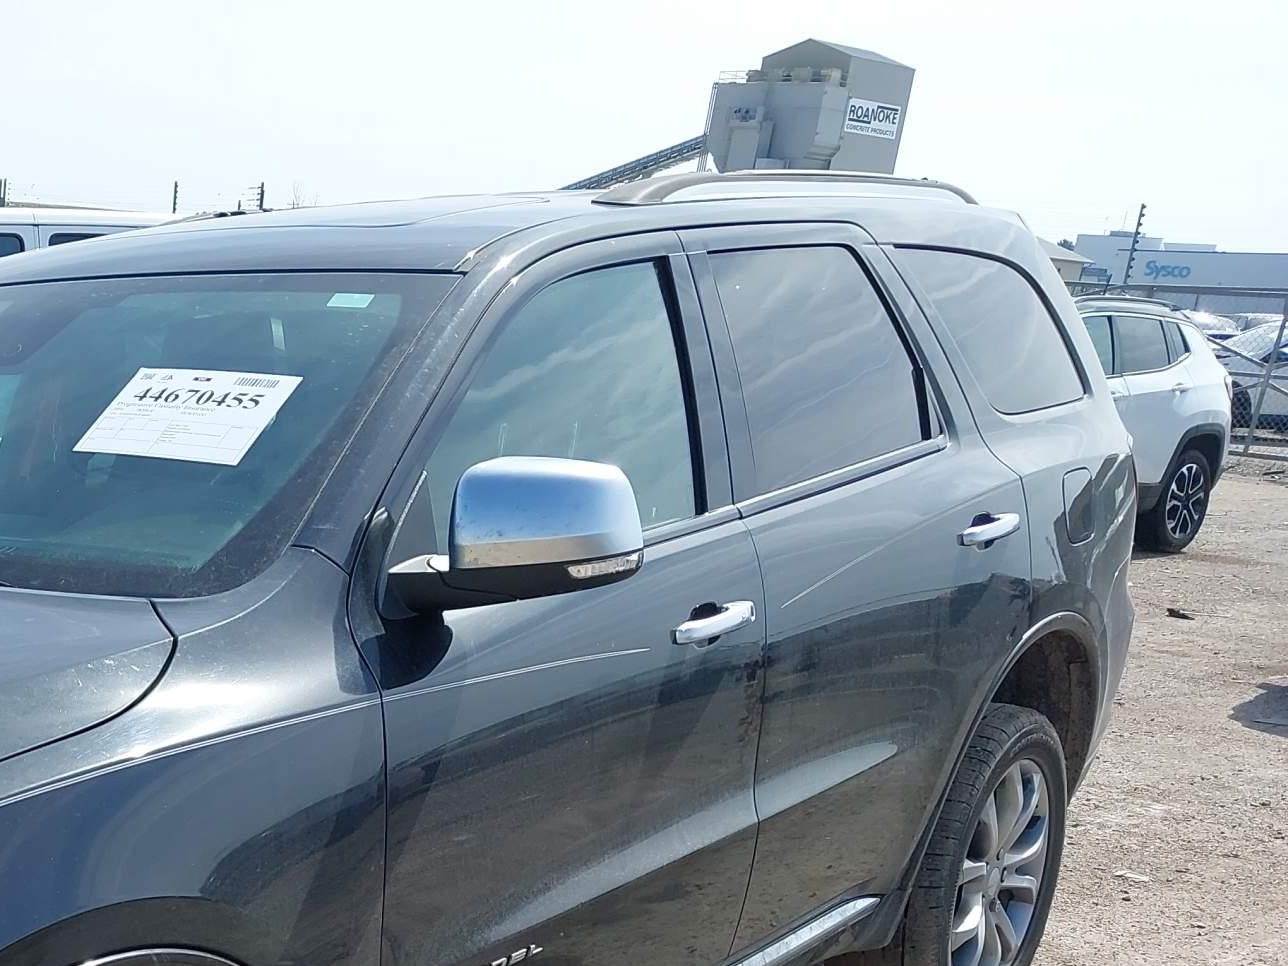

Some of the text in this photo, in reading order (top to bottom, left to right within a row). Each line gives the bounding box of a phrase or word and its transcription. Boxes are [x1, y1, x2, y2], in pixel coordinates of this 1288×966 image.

[848, 104, 899, 125] ROANOKE
[846, 123, 894, 137] CONCRETE PRODUCTS
[1144, 260, 1191, 280] Sysco
[133, 386, 266, 410] 44670455
